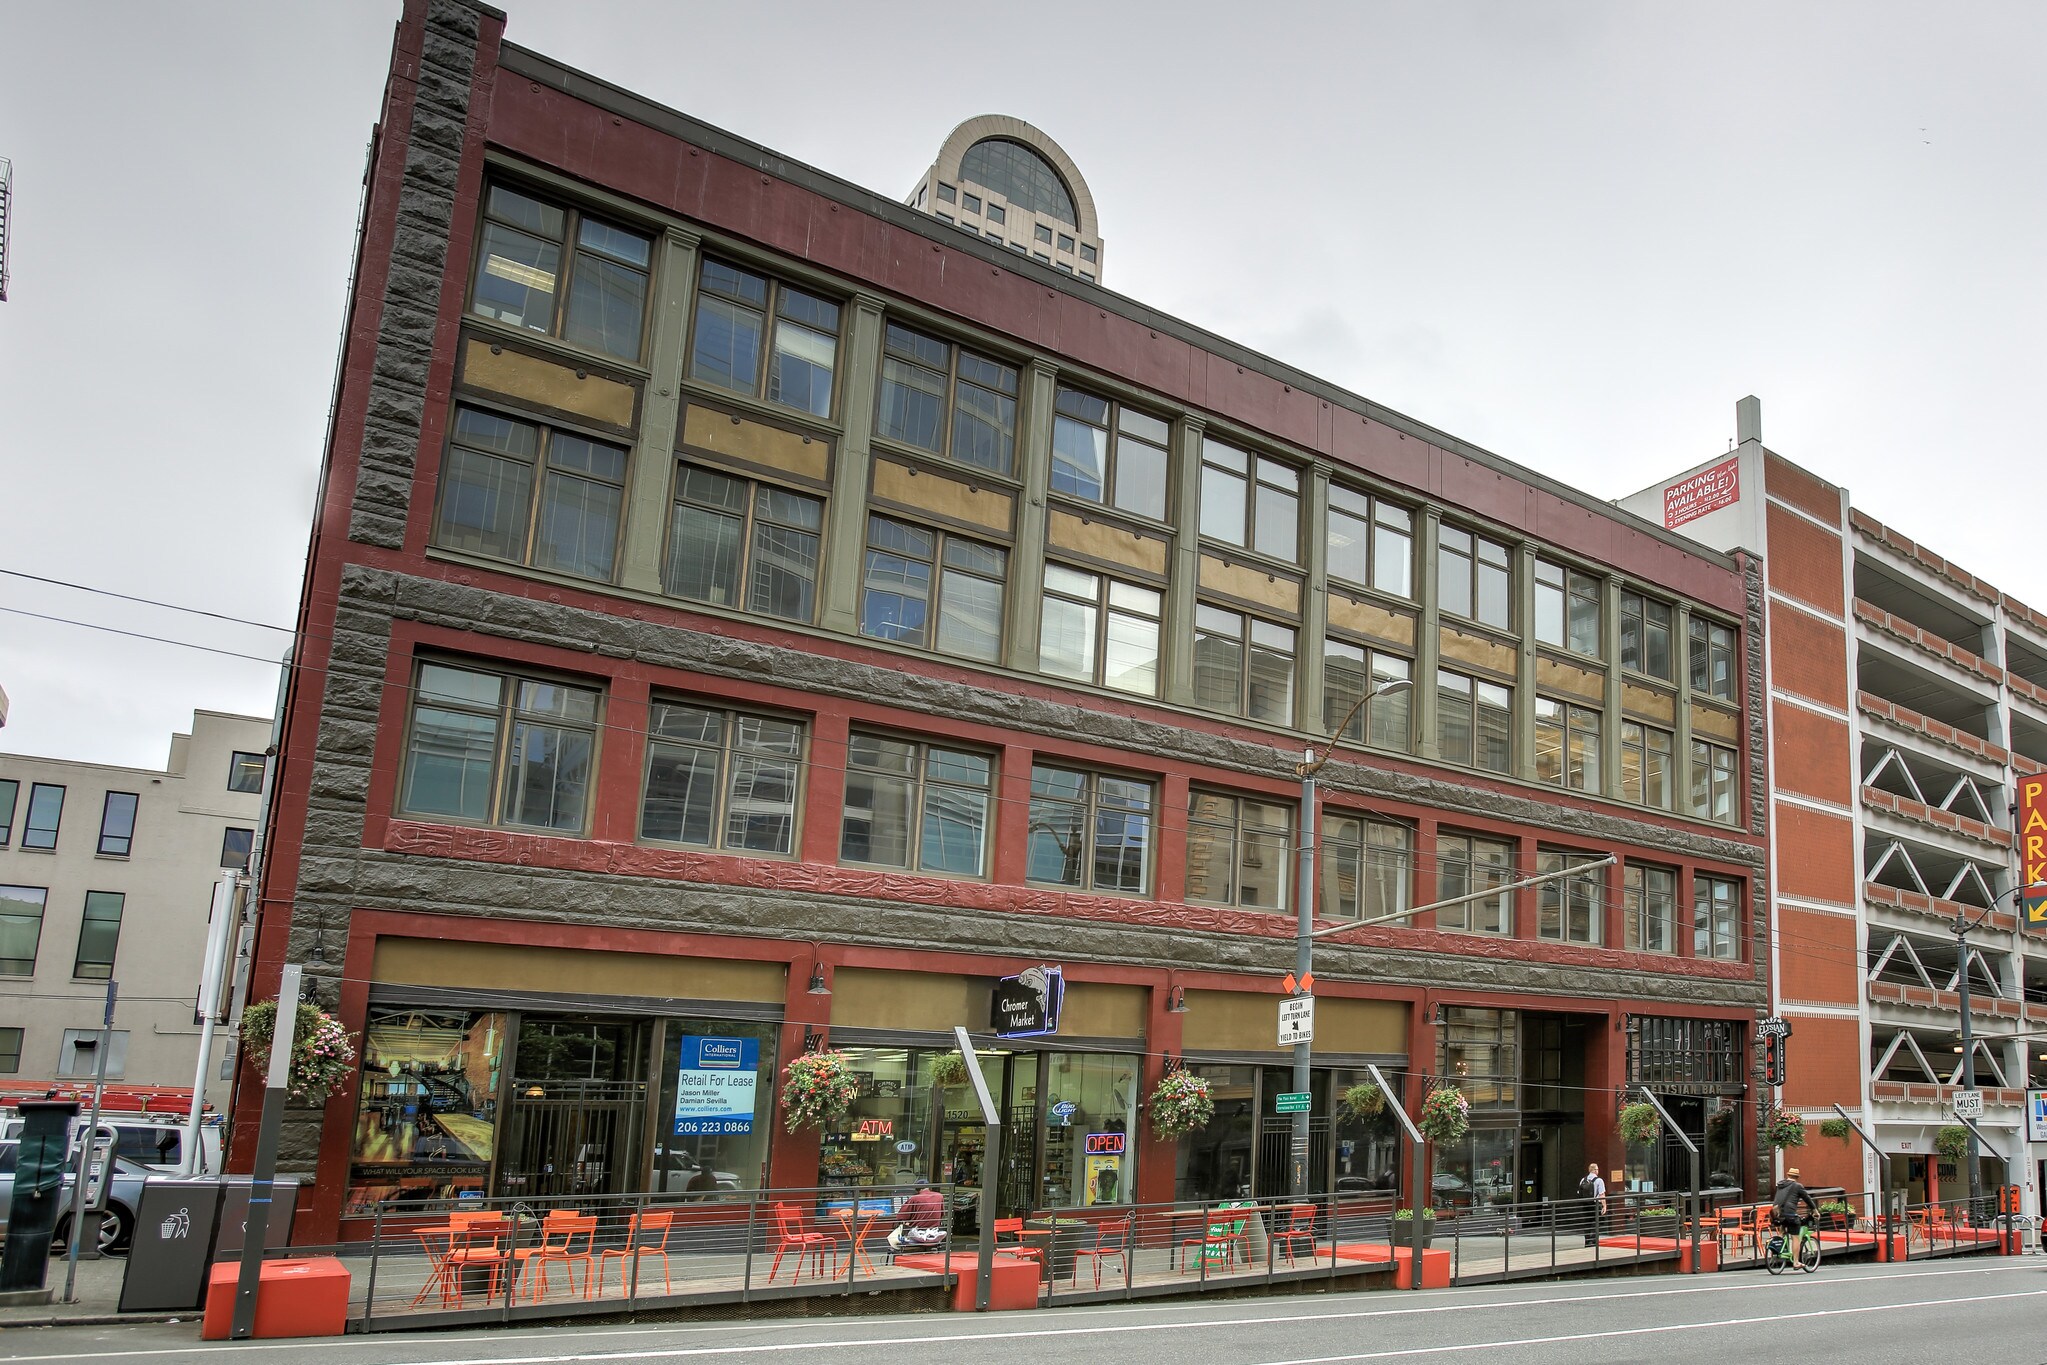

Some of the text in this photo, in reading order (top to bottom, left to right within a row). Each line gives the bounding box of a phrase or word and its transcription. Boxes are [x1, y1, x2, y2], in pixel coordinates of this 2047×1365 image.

[1666, 470, 1716, 500] PARKING
[1666, 477, 1729, 511] AVAILABLE!
[1674, 511, 1697, 525] EVENING
[1697, 504, 1712, 515] RATE
[1678, 502, 1698, 515] HOURS
[1001, 998, 1029, 1013] Chromer
[1290, 1002, 1303, 1011] BEGIN
[1010, 1012, 1035, 1028] Market
[1758, 1023, 1785, 1034] ELYSIAN
[704, 1043, 737, 1054] Colliers
[1766, 1036, 1774, 1079] BAR
[681, 1073, 754, 1087] Retail For Lease
[1651, 1084, 1722, 1095] ELYSIAN BAR
[1956, 1098, 1980, 1109] MUST
[947, 1110, 969, 1120] 1520
[677, 1121, 750, 1133] 206 223 0866
[859, 1120, 893, 1135] ATM
[1087, 1135, 1124, 1152] OPEN
[1901, 1142, 1912, 1150] EXIT
[401, 1167, 423, 1175] YOUR
[424, 1167, 446, 1175] SPACE
[468, 1166, 486, 1174] LIKE?
